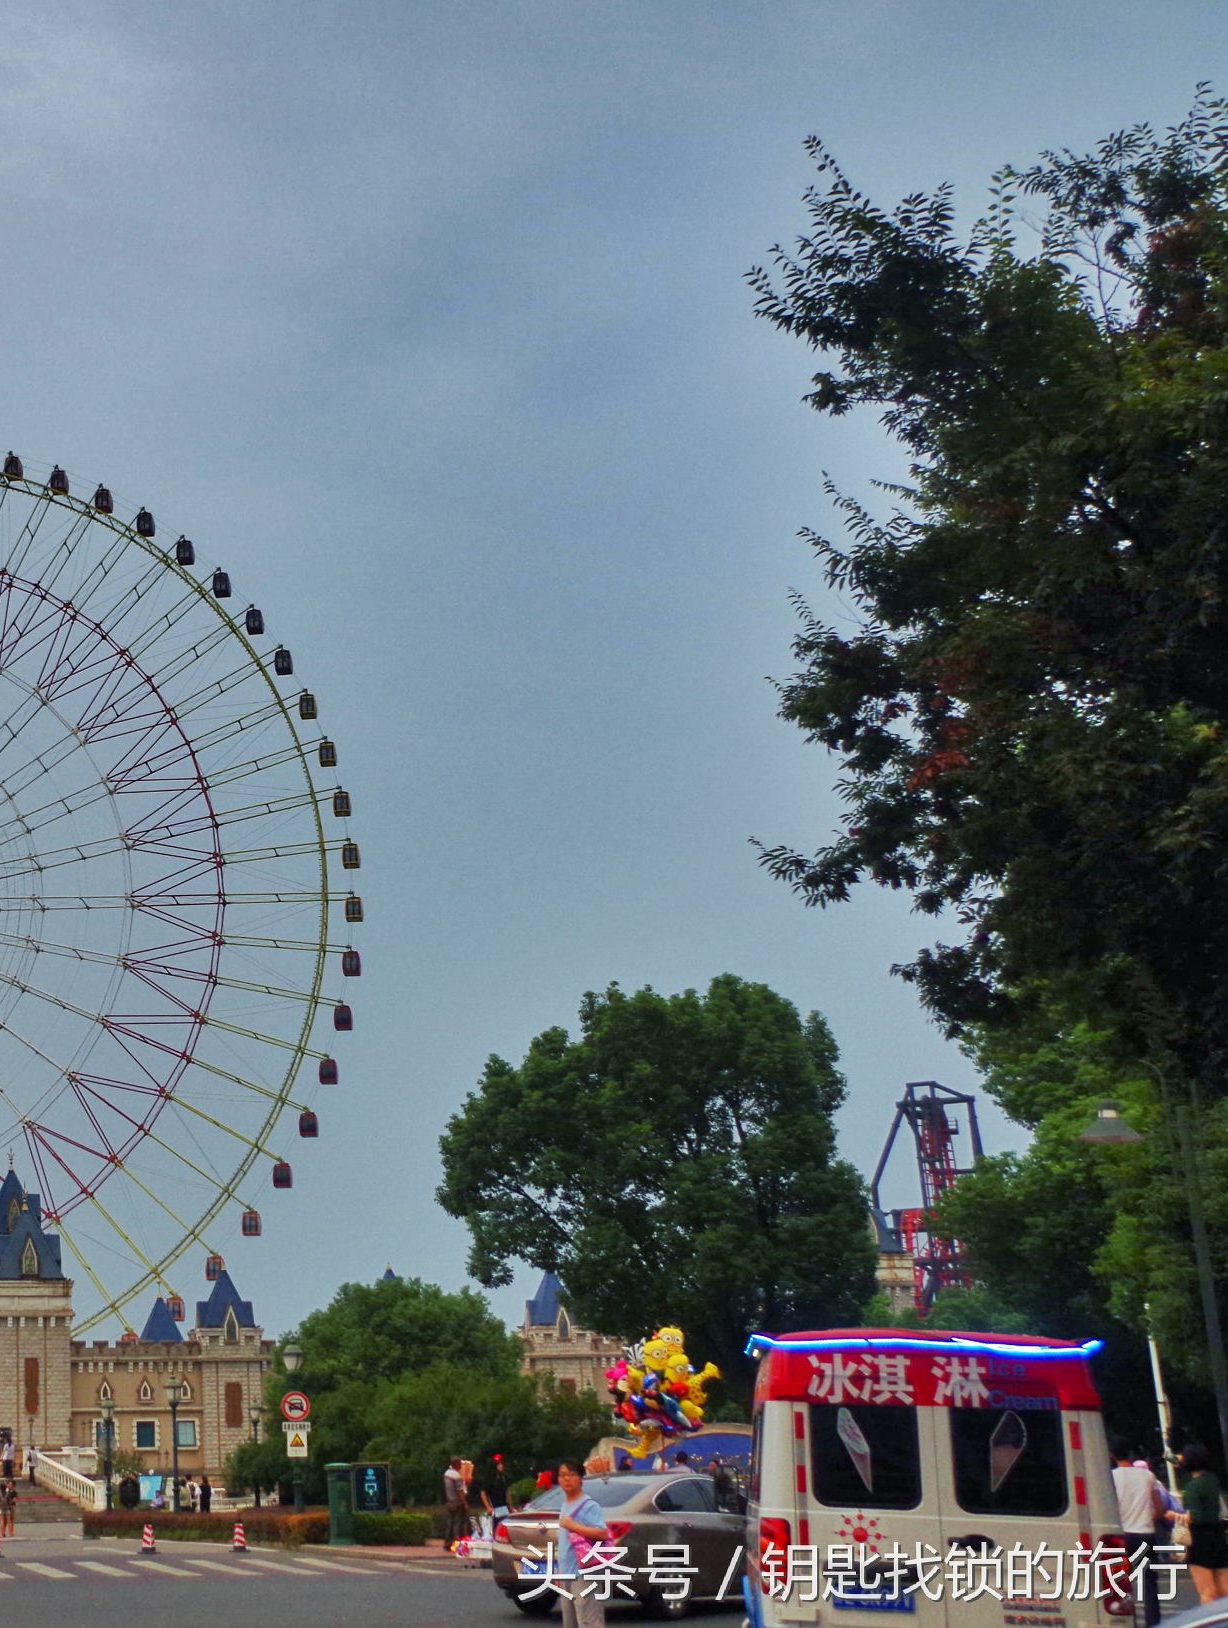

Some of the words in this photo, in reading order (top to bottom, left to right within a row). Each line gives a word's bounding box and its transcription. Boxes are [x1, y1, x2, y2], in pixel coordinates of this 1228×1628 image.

[989, 1358, 1027, 1377] Ice
[807, 1353, 989, 1408] 冰淇淋
[987, 1389, 1058, 1410] Cream
